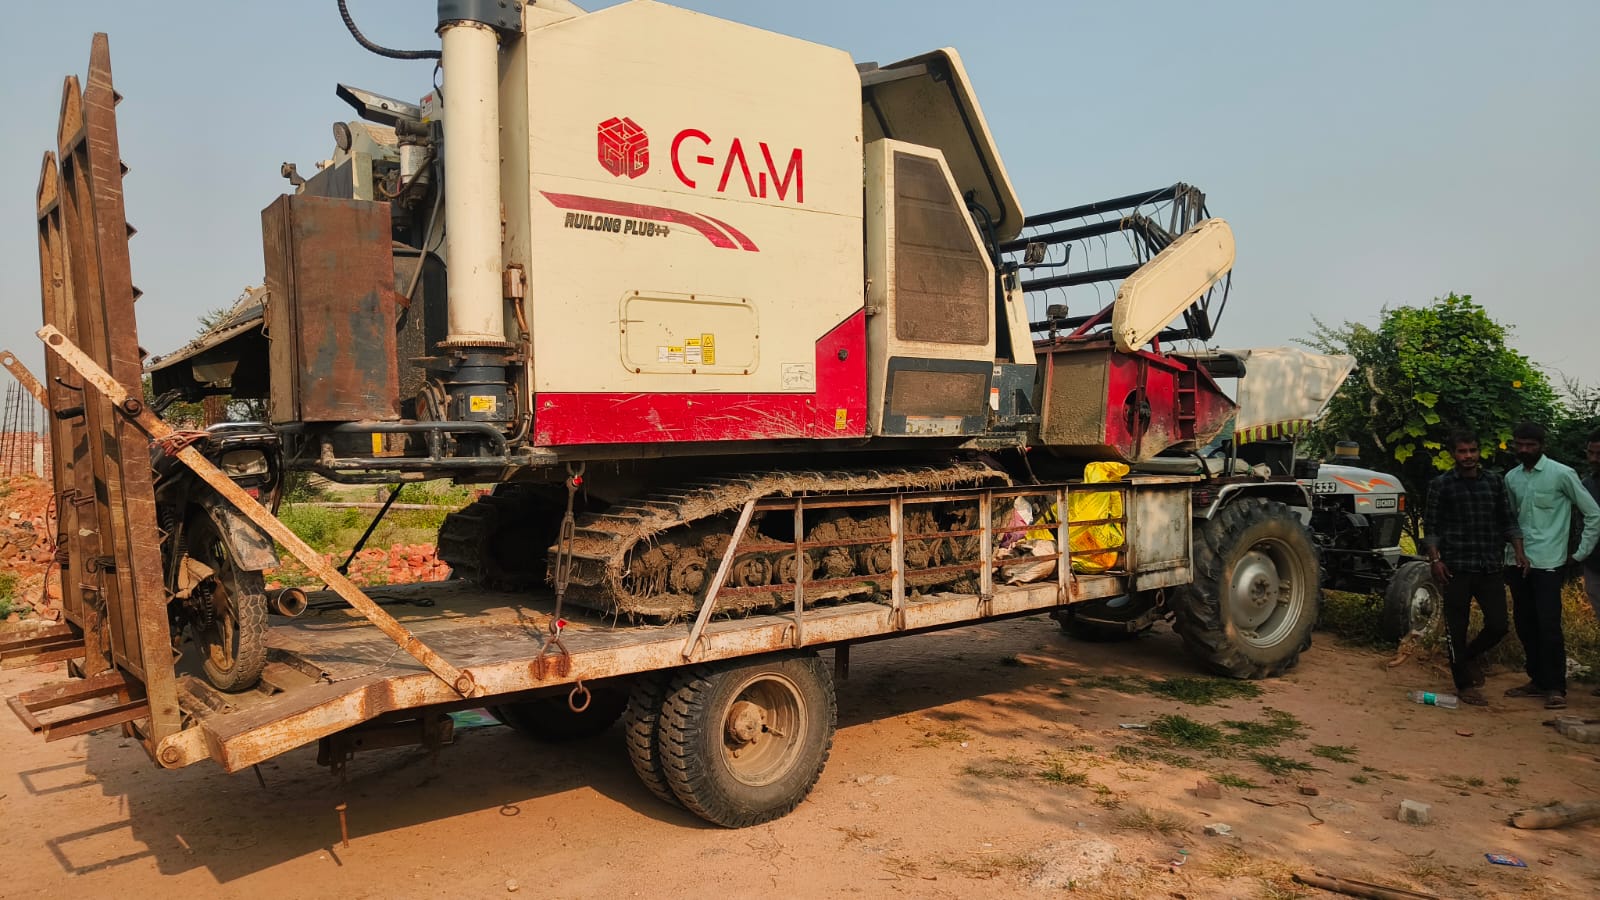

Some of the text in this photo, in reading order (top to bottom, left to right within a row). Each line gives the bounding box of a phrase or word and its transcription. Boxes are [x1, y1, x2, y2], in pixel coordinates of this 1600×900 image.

[671, 128, 803, 203] GAM
[564, 212, 622, 233] RUILONG
[1316, 482, 1336, 493] 333
